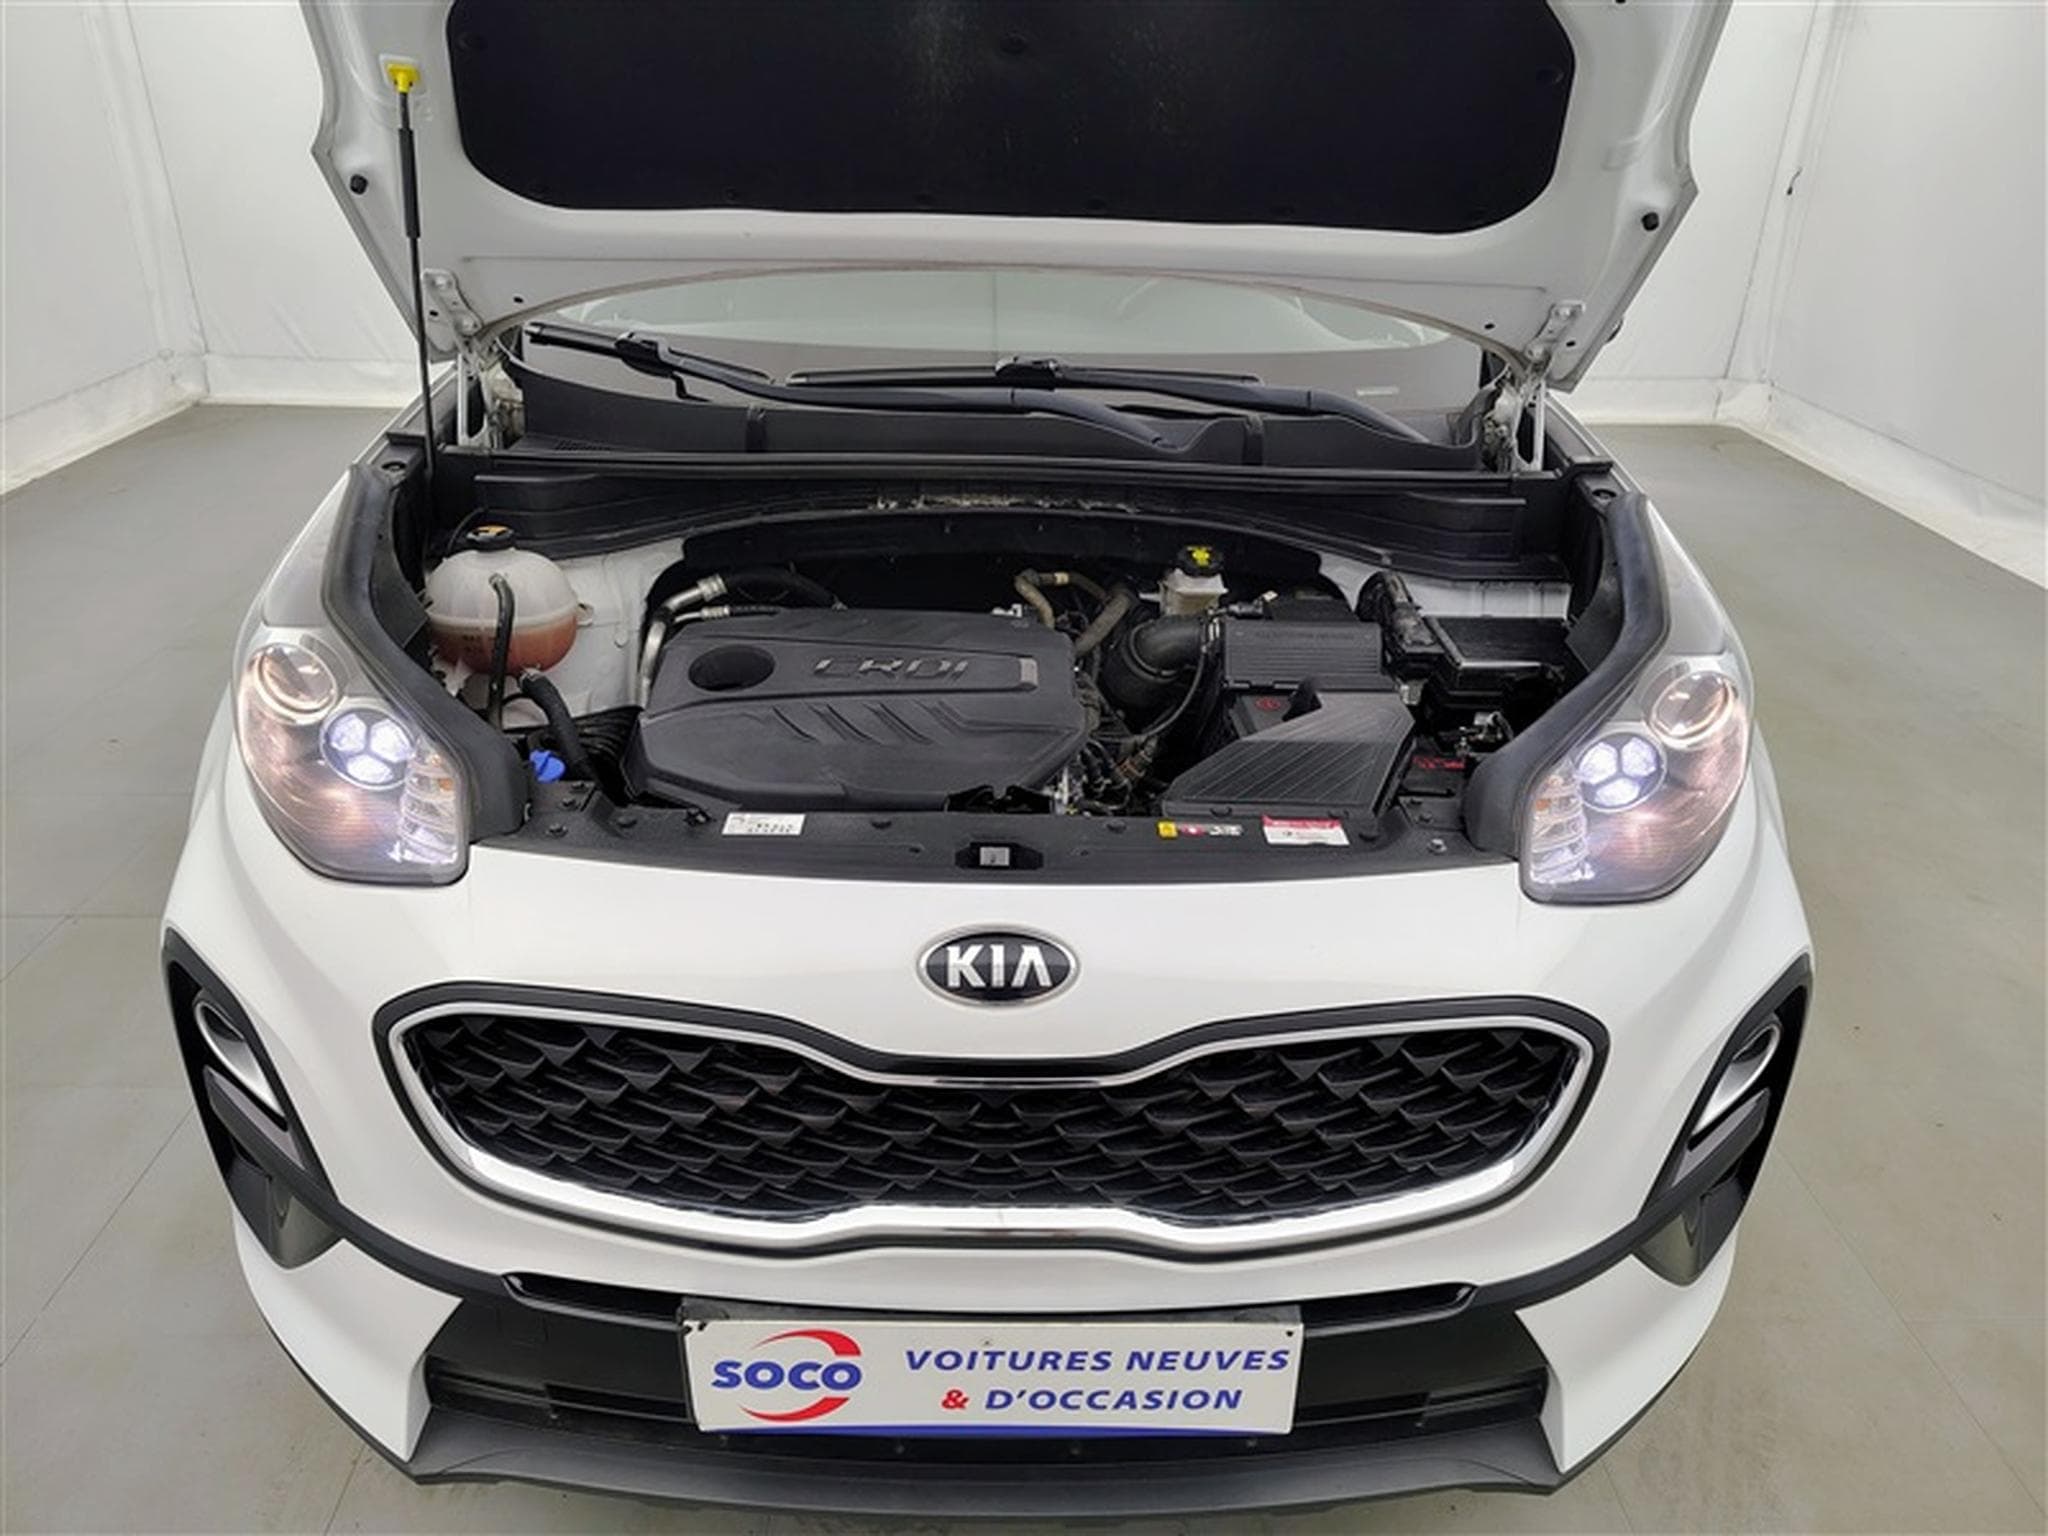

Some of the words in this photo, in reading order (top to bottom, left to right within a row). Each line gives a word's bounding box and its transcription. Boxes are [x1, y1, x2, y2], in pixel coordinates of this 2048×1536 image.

[946, 943, 1053, 988] KIA
[905, 1350, 1113, 1371] VOITURES
[1126, 1349, 1291, 1371] NEUVES
[711, 1361, 862, 1391] SOCO
[941, 1388, 970, 1410] &
[985, 1389, 1243, 1411] D'OCCASION
